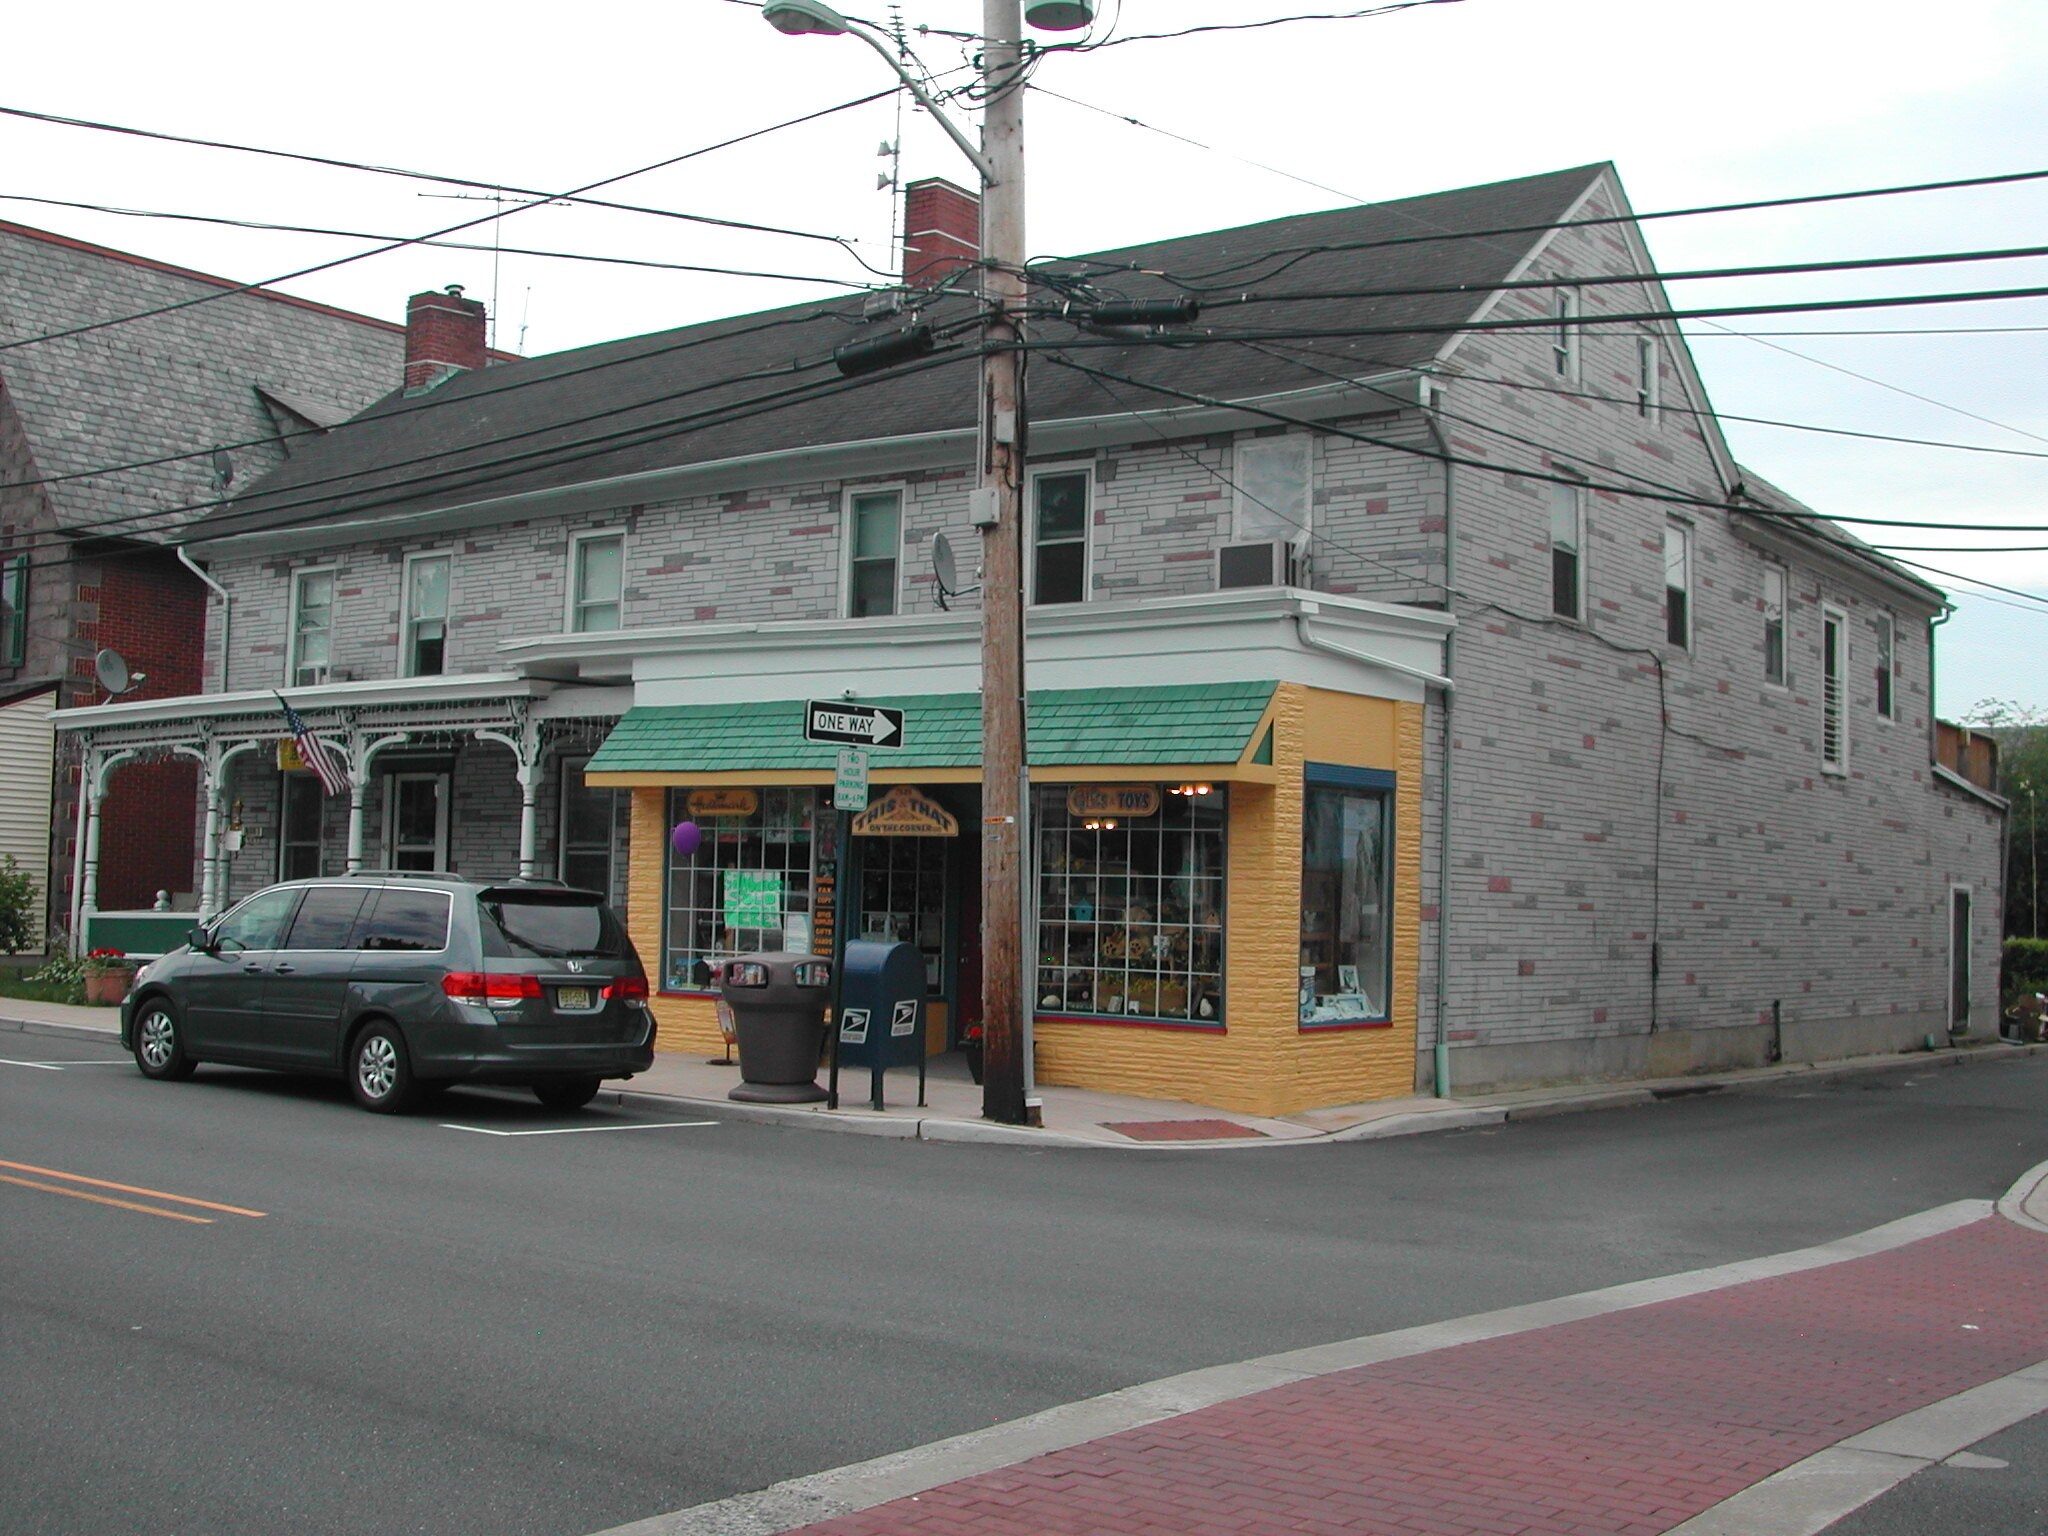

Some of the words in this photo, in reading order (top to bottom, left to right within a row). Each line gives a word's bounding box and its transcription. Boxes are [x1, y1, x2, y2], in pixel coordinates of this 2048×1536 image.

[818, 713, 845, 731] ONE
[849, 716, 874, 733] WAY
[843, 767, 861, 777] HOUR
[838, 779, 865, 789] PARKING
[1117, 791, 1150, 809] TOYS
[855, 799, 897, 831] THIS
[909, 799, 953, 832] THAT
[869, 823, 881, 832] ON
[883, 823, 899, 832] THE
[899, 823, 932, 832] CORNER
